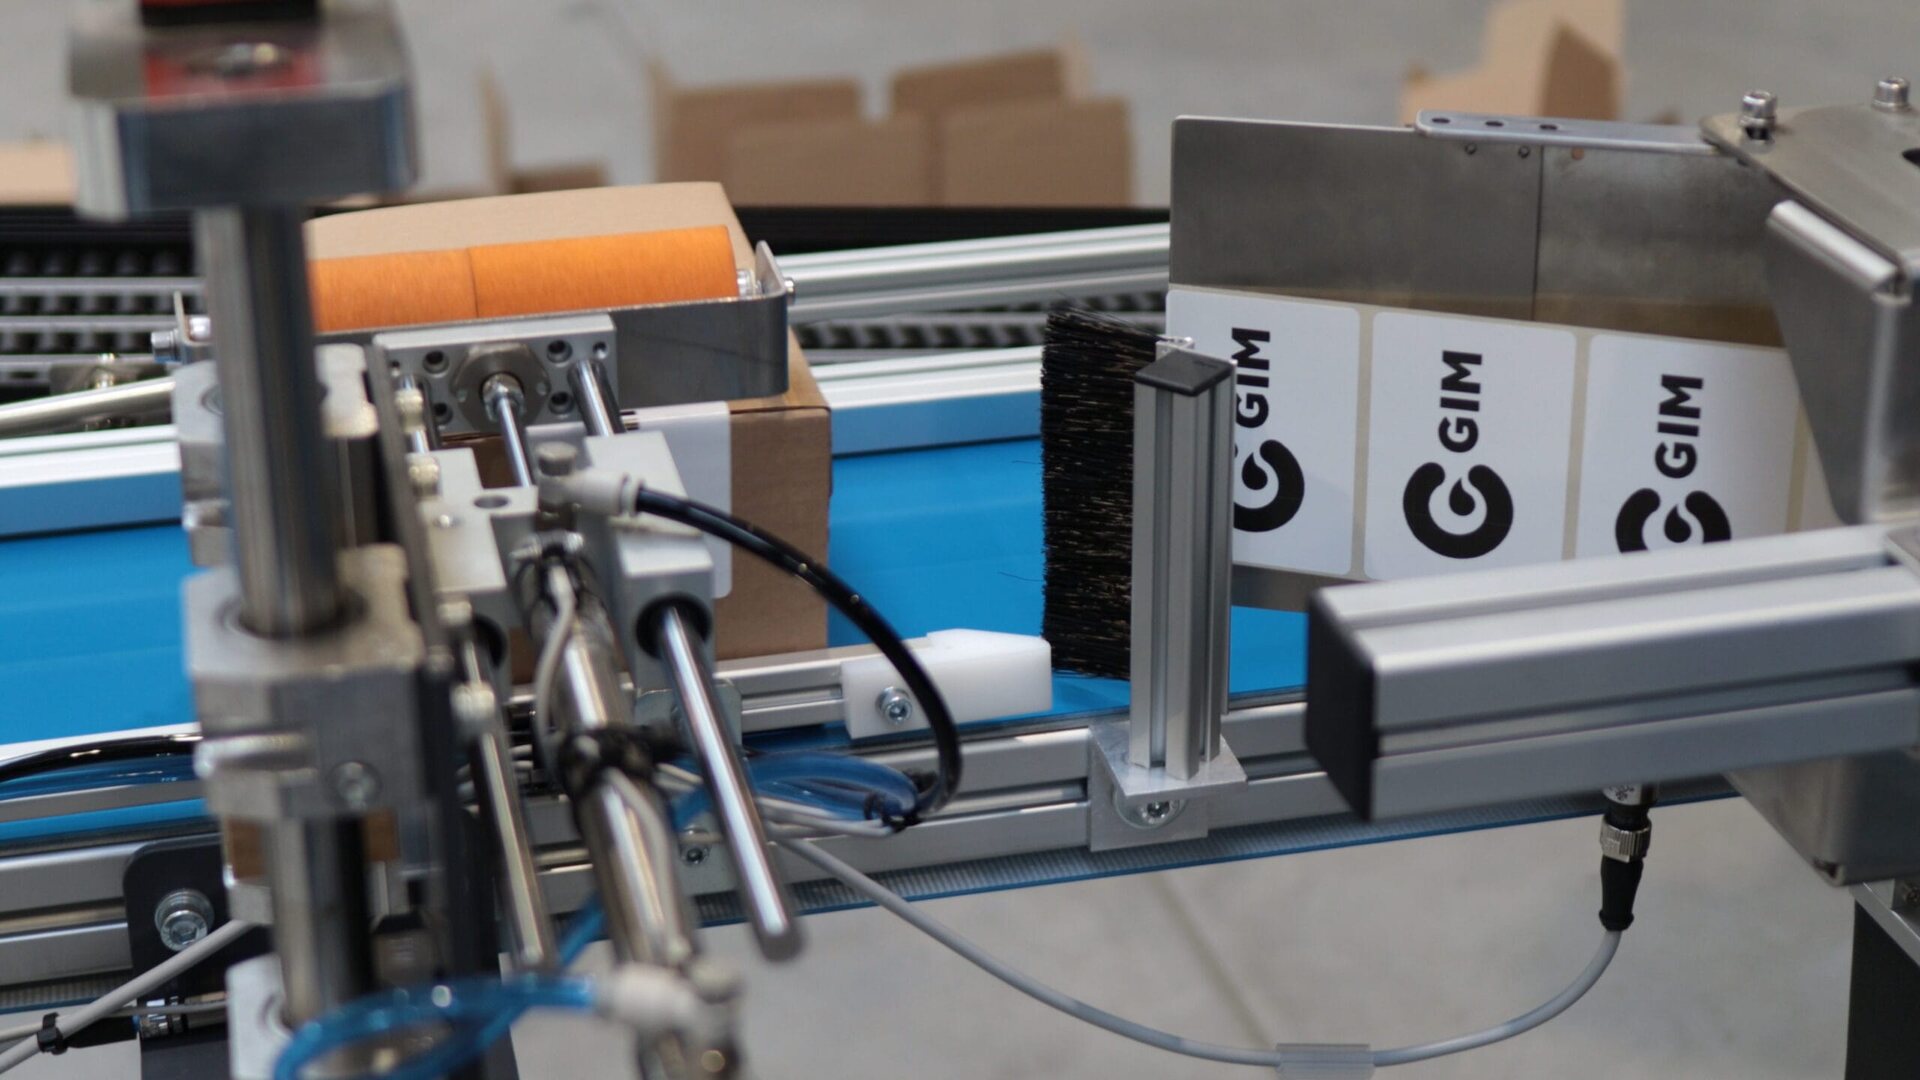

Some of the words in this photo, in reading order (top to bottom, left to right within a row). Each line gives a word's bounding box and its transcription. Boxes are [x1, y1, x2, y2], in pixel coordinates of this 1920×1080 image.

[1231, 327, 1270, 429] GIM
[1439, 350, 1482, 454] GIM
[1655, 374, 1703, 479] GIM
